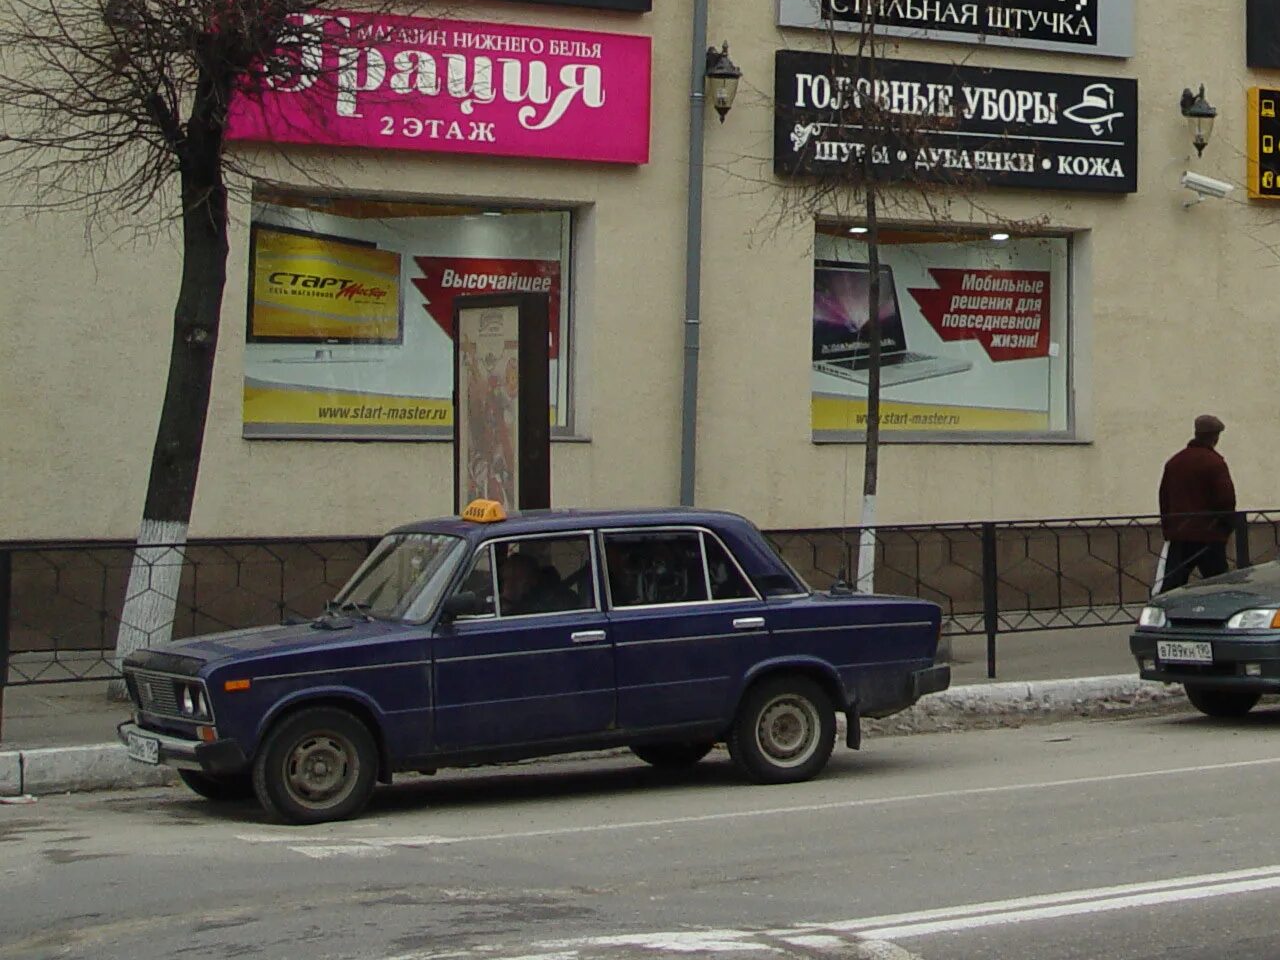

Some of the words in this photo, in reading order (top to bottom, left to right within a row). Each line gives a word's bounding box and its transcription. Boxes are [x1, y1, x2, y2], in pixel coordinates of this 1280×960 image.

[986, 5, 1093, 37] ШТУЧКА
[453, 32, 544, 54] НИЖНЕГО
[549, 40, 602, 59] БЕЛЬЯ
[795, 73, 954, 118] ГОЛОВНЫЕ
[961, 84, 1058, 125] УБОРЫ
[379, 116, 395, 136] 2
[402, 117, 497, 142] ЭТАЖ
[914, 147, 1036, 172] ДУБЛЕНКИ
[1056, 155, 1125, 178] КОЖА
[441, 268, 552, 292] Высочайшее
[961, 273, 1044, 294] Мобильные
[950, 294, 1013, 312] решения
[1015, 298, 1042, 313] для
[941, 313, 1041, 331] повседневной
[990, 332, 1039, 348] жизни!
[318, 404, 447, 421] www.start-master.ru
[856, 412, 960, 425] w.start-master.ru
